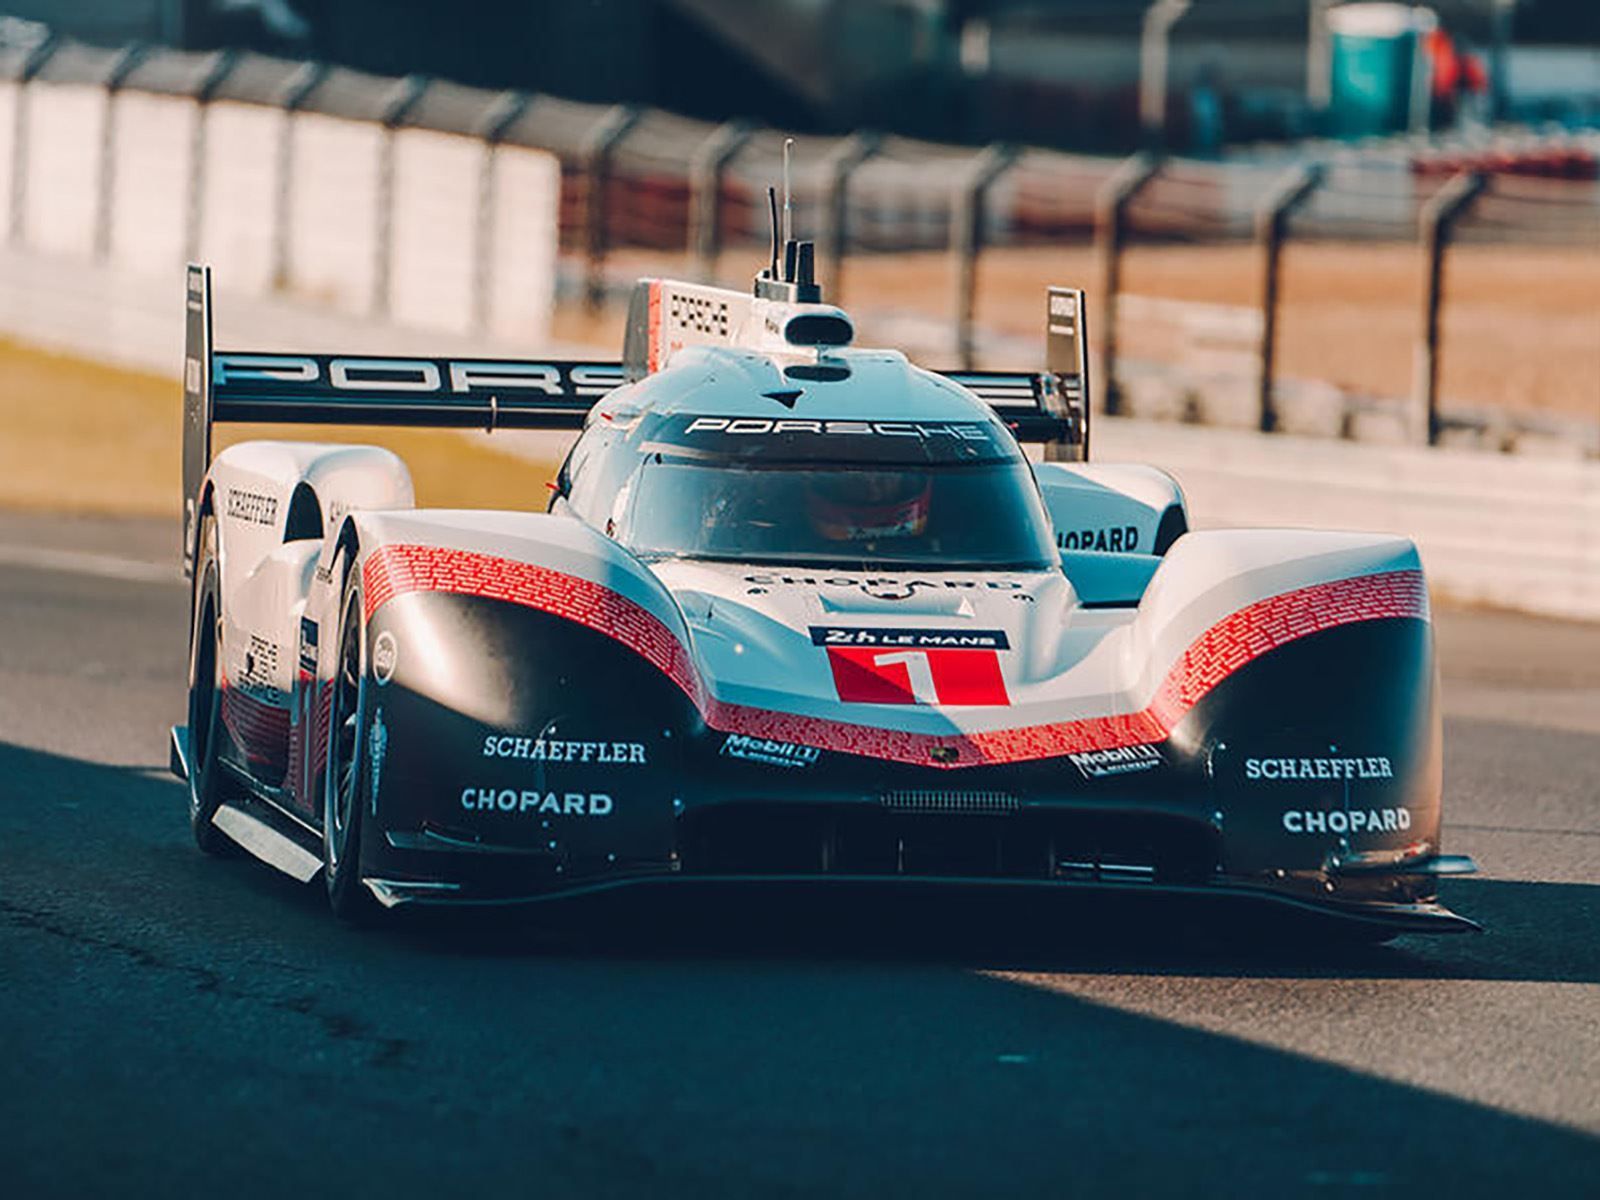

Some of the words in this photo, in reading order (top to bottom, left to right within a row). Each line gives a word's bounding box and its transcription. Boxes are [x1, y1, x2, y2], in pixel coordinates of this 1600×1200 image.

[684, 417, 990, 441] PORSCHE
[1056, 526, 1139, 552] OPARD
[882, 634, 914, 645] LE
[919, 635, 997, 646] MANS
[873, 650, 942, 706] 1
[482, 734, 647, 765] SCHAEFFLER
[1245, 757, 1393, 779] SCHAEFFLER
[460, 789, 613, 815] CHOPARD
[1283, 808, 1411, 833] CHOPARD
